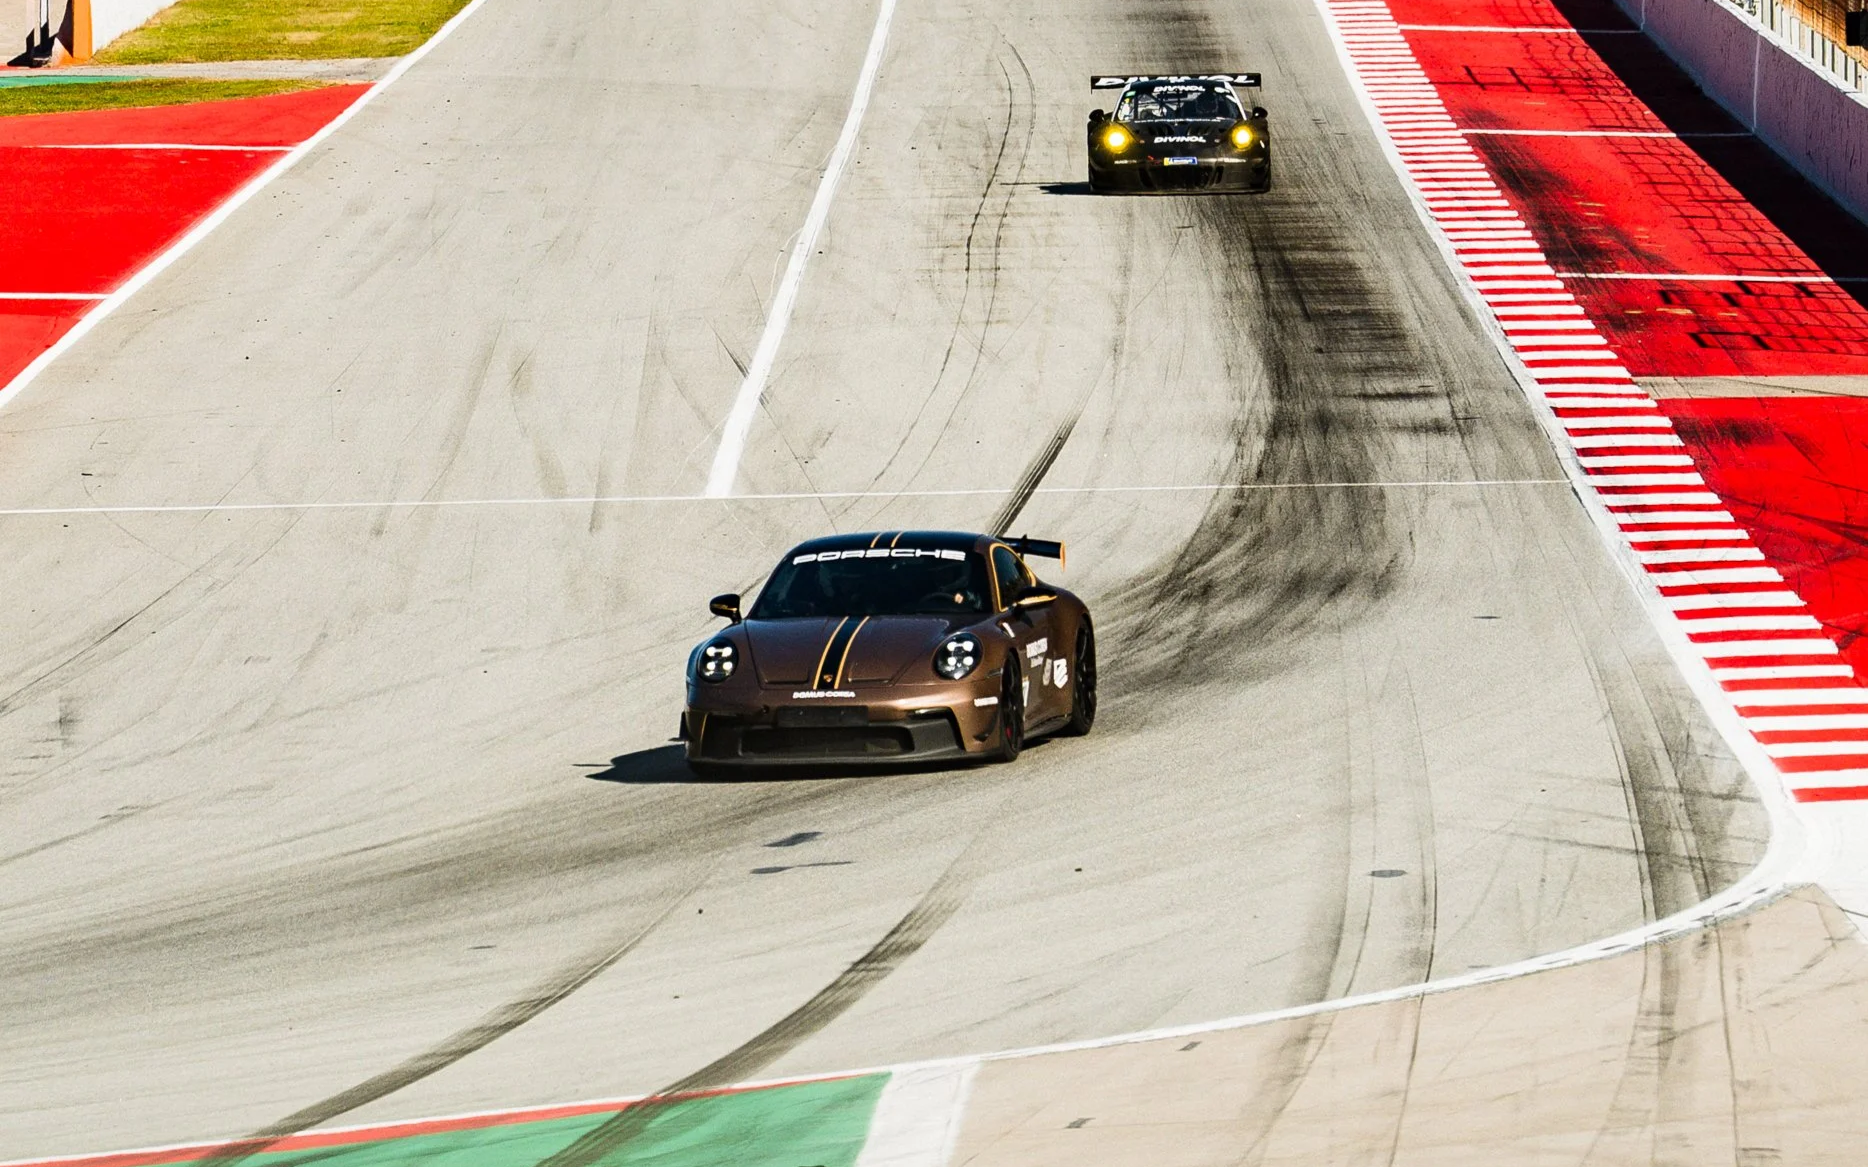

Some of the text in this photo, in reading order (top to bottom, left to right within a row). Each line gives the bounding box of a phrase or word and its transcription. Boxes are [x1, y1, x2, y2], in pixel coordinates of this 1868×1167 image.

[1153, 85, 1206, 93] DIVINOL
[1153, 136, 1206, 144] DIVINOL
[792, 548, 966, 566] PORSCHE
